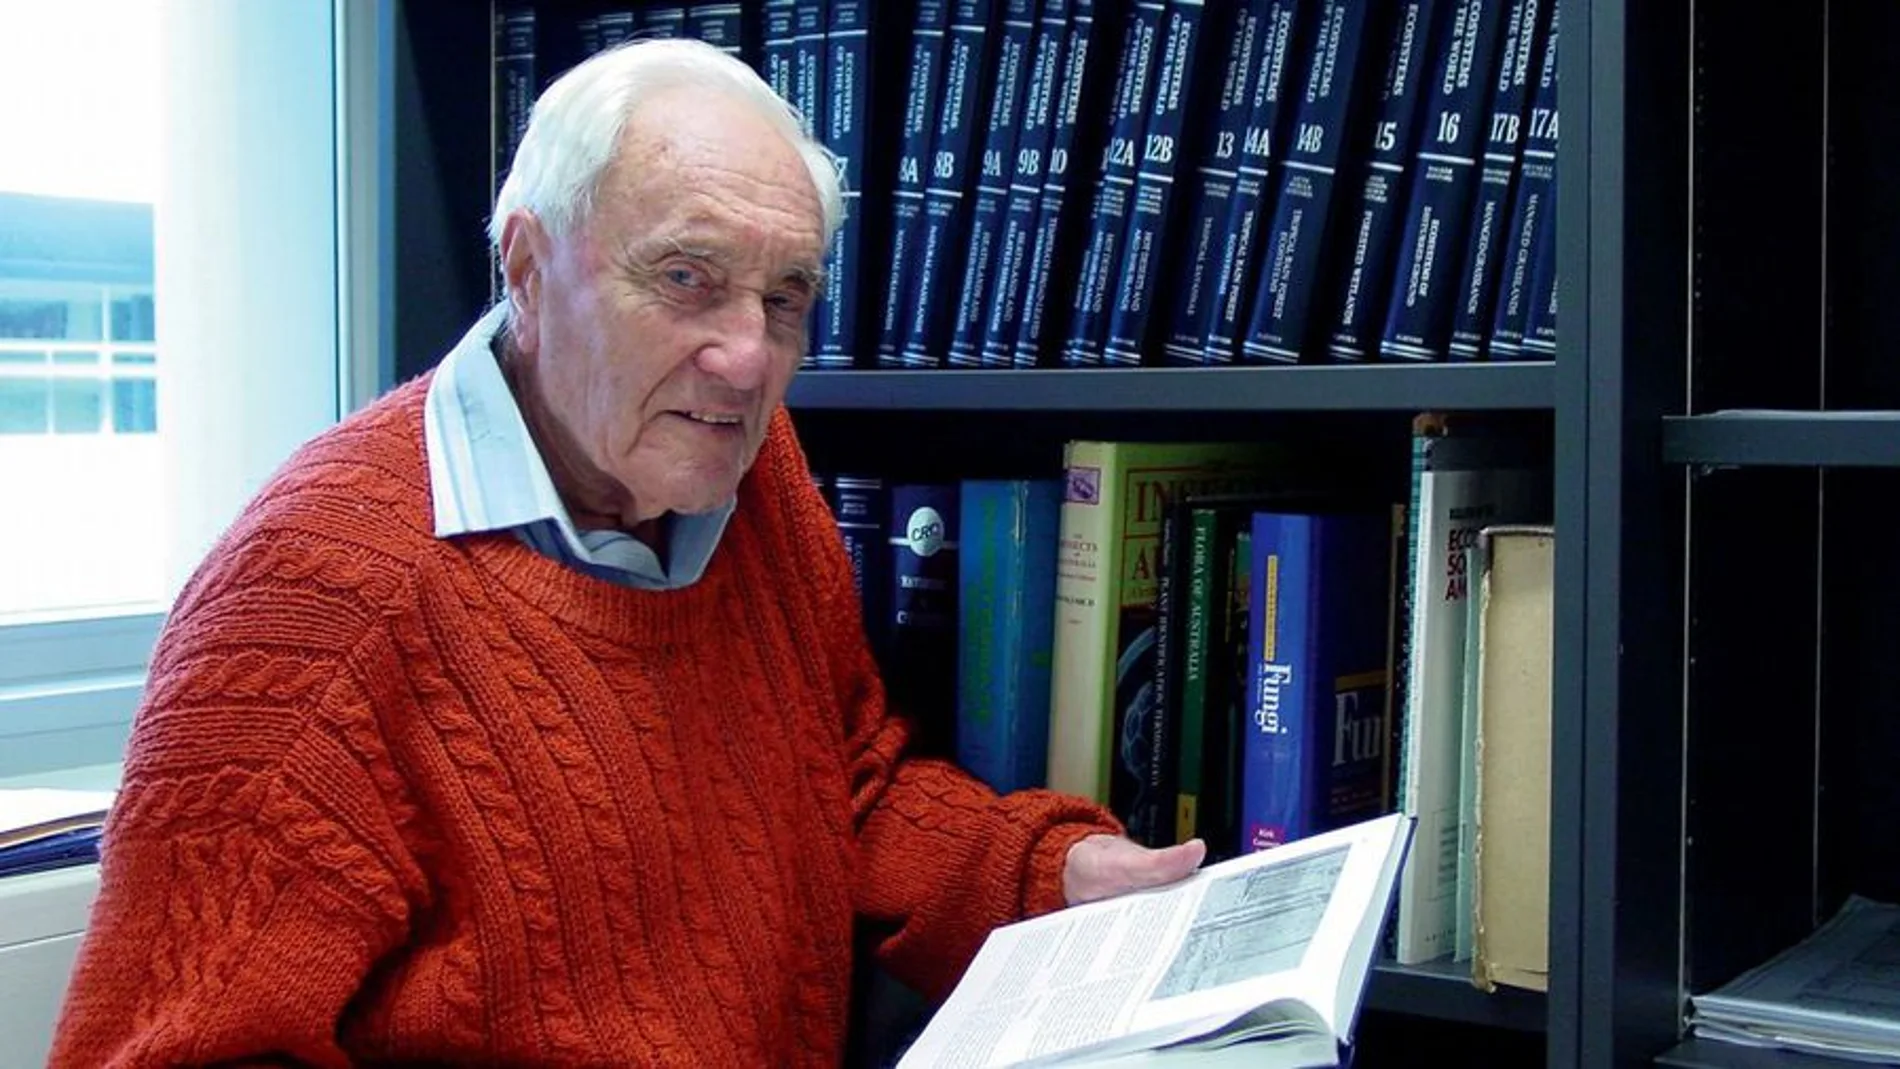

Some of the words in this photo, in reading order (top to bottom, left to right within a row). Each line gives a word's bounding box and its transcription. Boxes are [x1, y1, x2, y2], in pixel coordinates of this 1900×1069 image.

[1170, 12, 1183, 34] OF
[1270, 1, 1282, 22] OF
[1316, 20, 1332, 49] THE
[1452, 7, 1469, 38] THE
[1508, 5, 1524, 37] THE
[836, 45, 846, 61] OF
[1164, 34, 1179, 64] THE
[1231, 31, 1244, 58] THE
[1232, 16, 1258, 106] ECOSYSTEMS
[1264, 24, 1279, 54] THE
[1265, 10, 1293, 103] ECOSYSTEMS
[1318, 6, 1346, 99] ECOSYSTEMS
[1392, 3, 1420, 97] ECOSYSTEMS
[1456, 0, 1483, 88] COSYSTEMS
[1513, 0, 1538, 86] COSYSTEMS
[1540, 32, 1560, 88] WORLD
[834, 65, 845, 91] THE
[949, 44, 971, 129] ECOSYSTEMS
[999, 43, 1022, 127] ECOSYSTEMS
[1035, 40, 1059, 125] ECOSYSTEMS
[1065, 38, 1090, 125] ECOSYSTEMS
[1129, 26, 1156, 114] ECOSYSTEMS
[1166, 21, 1193, 111] ECOSYSTEMS
[1219, 60, 1239, 112] WORLD
[1253, 54, 1272, 109] WORLD
[1305, 51, 1326, 104] WORLD
[1442, 38, 1464, 96] WORLD
[1497, 37, 1518, 93] WORLD
[842, 51, 855, 133] ECOSYSTEMS
[903, 91, 917, 139] WORLD
[913, 51, 932, 133] ECOSYSTEMS
[939, 86, 955, 136] WORLD
[988, 84, 1005, 132] WORLD
[1024, 82, 1043, 131] WORLD
[1055, 80, 1073, 130] WORLD
[1118, 69, 1137, 120] WORLD
[1154, 65, 1174, 117] WORLD
[832, 94, 843, 140] WORLD
[1242, 125, 1272, 158] 14A
[1295, 122, 1325, 154] 14B
[1373, 121, 1398, 151] 15
[1435, 111, 1462, 144] 16
[1488, 112, 1521, 144] 17B
[1528, 107, 1559, 140] 17A
[932, 150, 956, 179] 8B
[1017, 147, 1041, 176] 9B
[1048, 147, 1069, 175] 10
[1106, 137, 1135, 168] 12A
[1143, 133, 1175, 164] 12B
[1214, 130, 1236, 160] 13
[1236, 209, 1255, 257] TROPICAL
[1284, 208, 1304, 255] TROPICAL
[1353, 210, 1374, 266] FORESTED
[1520, 192, 1539, 249] MANAGED
[1341, 267, 1364, 326] WETLANDS
[1192, 525, 1206, 577] FLORA
[1160, 576, 1171, 612] PLANT
[1190, 577, 1204, 598] OF
[1187, 604, 1203, 681] AUSTRALIA
[1254, 662, 1293, 735] Fungi
